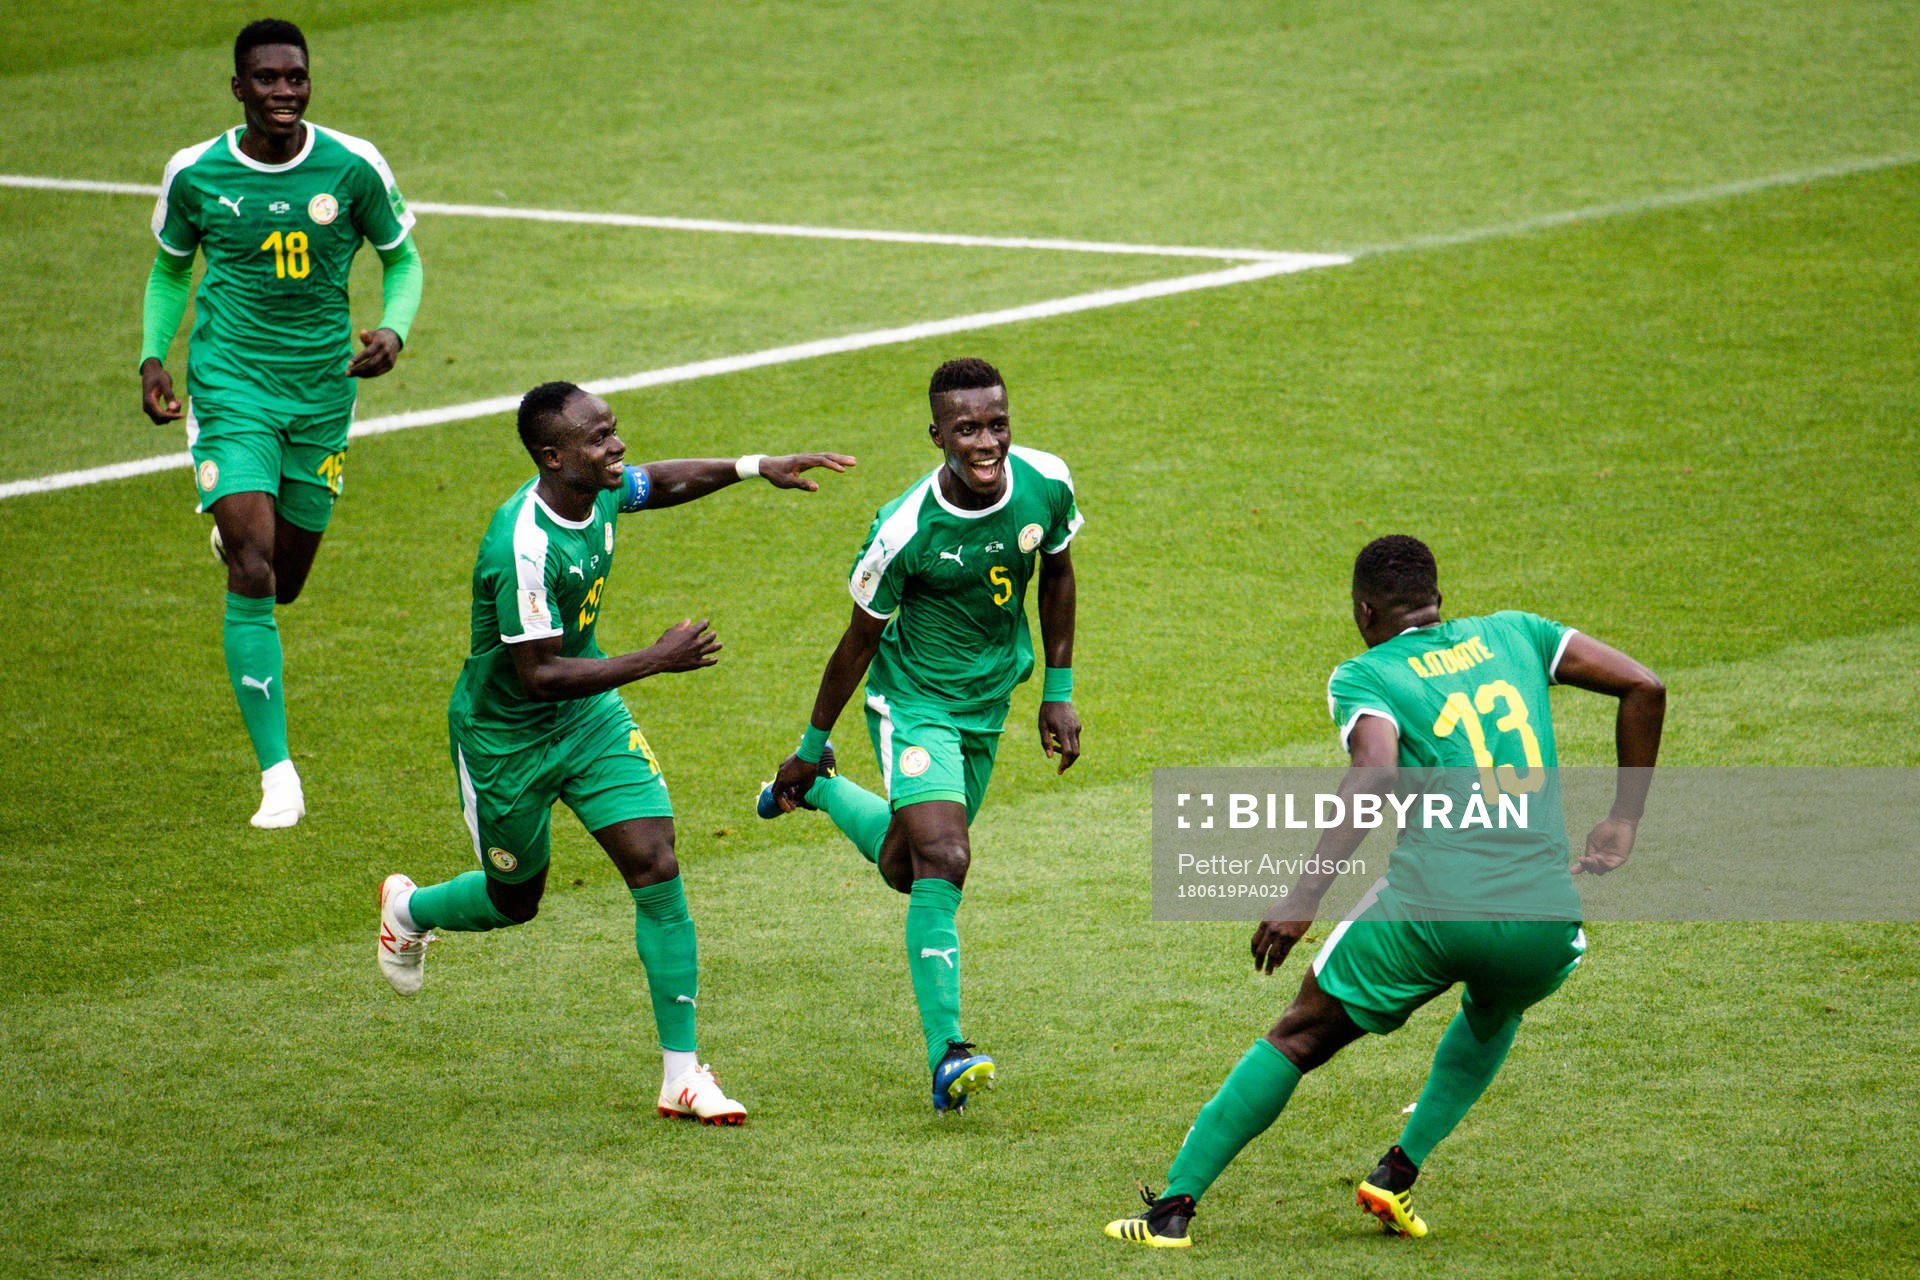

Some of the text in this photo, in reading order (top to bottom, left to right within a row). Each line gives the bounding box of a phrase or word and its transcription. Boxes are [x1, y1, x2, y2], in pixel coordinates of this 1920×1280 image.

[261, 231, 311, 279] 18
[989, 566, 1013, 606] 5
[1432, 680, 1546, 805] 13
